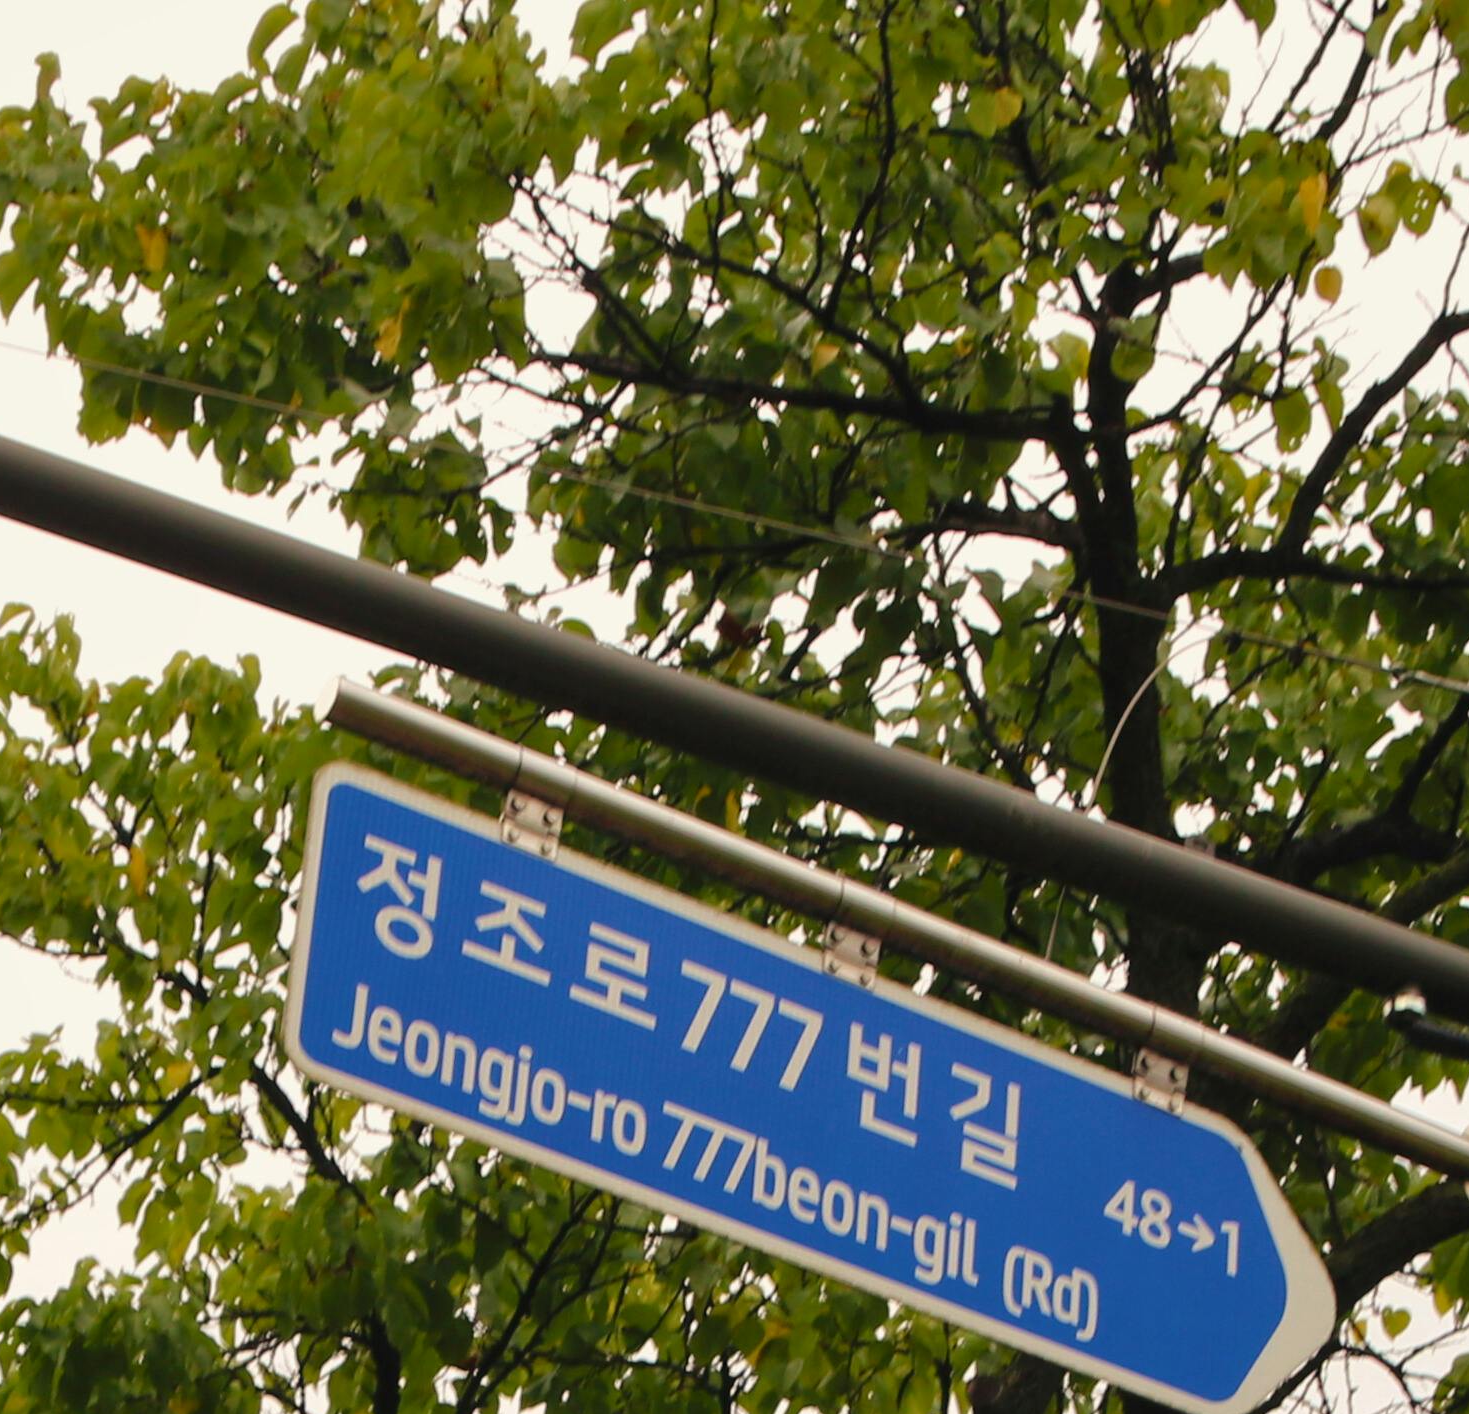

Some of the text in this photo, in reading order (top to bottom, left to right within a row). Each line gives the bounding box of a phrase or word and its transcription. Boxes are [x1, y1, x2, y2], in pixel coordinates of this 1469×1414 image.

[332, 983, 1099, 1341] Jeongjo-ro 777beon-gil (Rd)
